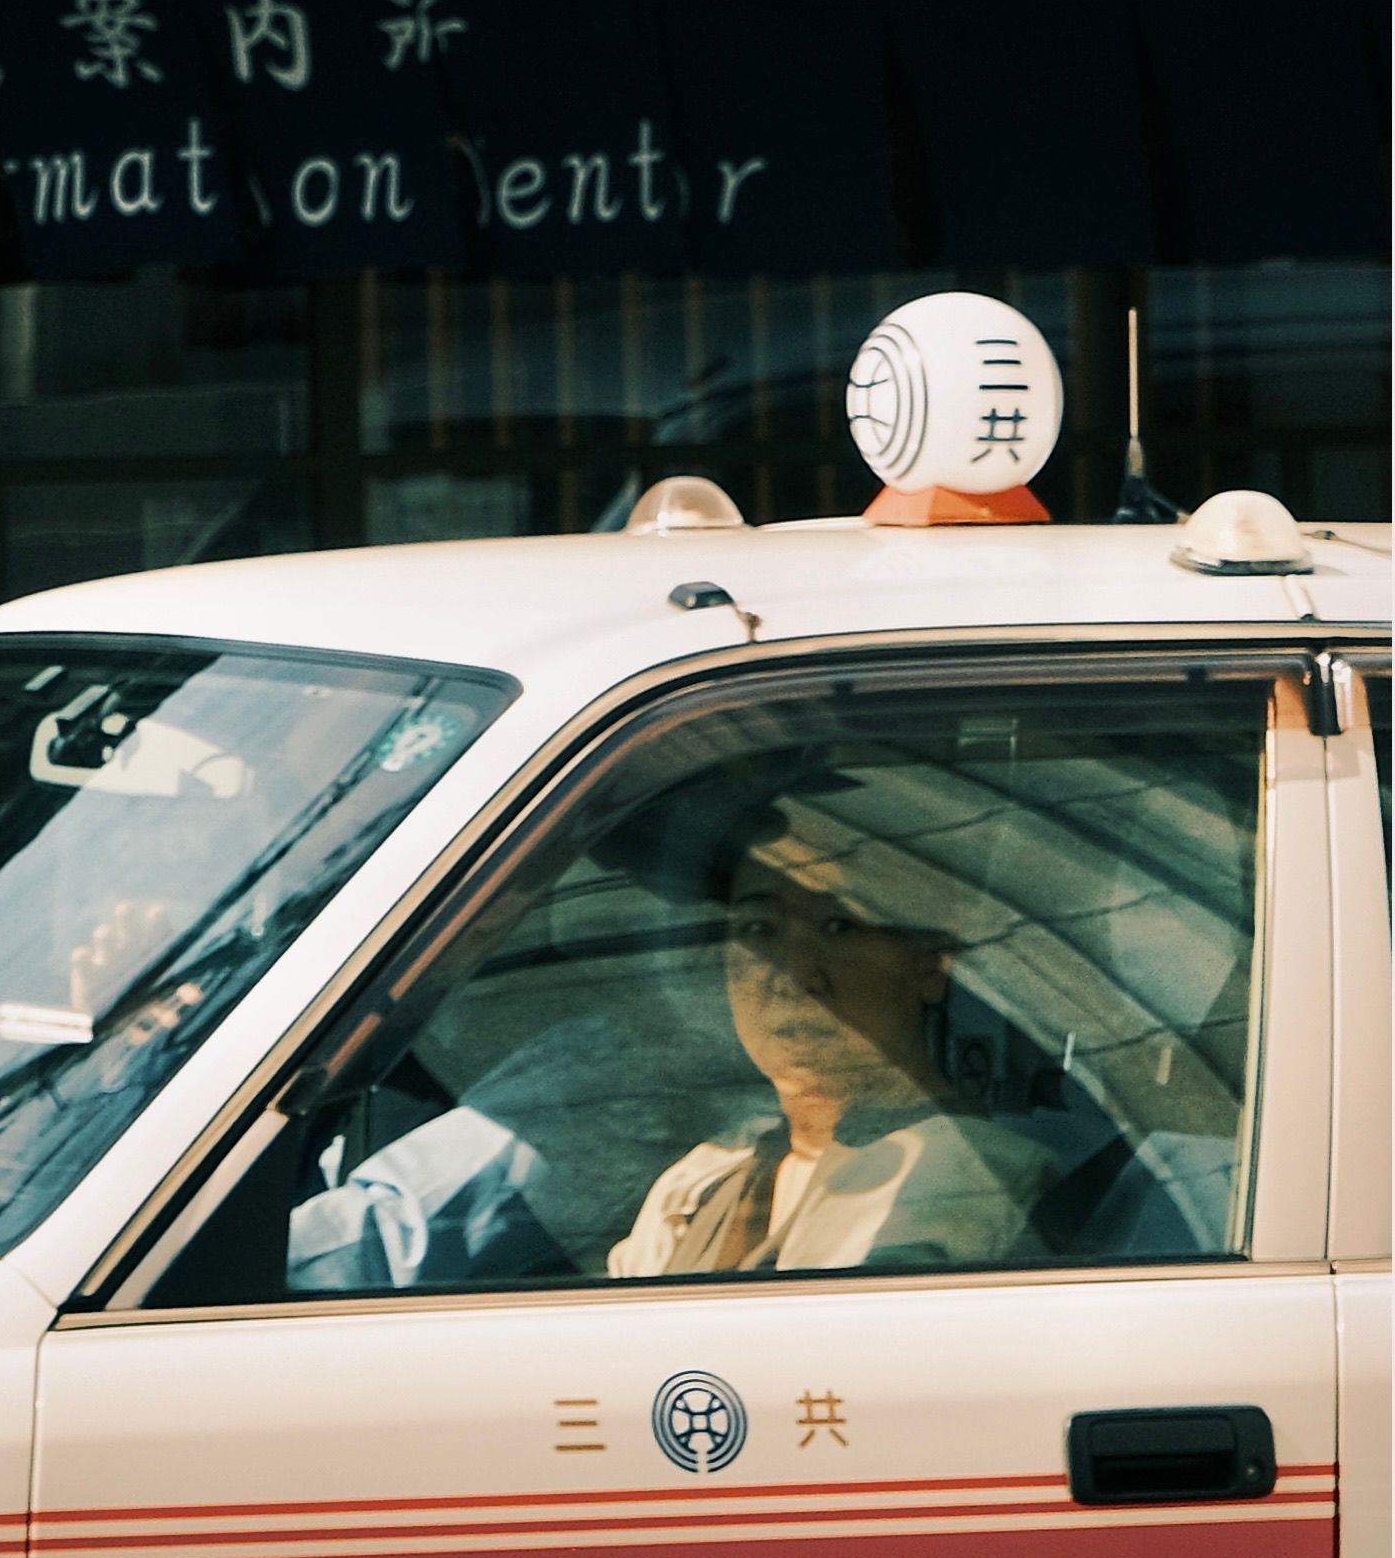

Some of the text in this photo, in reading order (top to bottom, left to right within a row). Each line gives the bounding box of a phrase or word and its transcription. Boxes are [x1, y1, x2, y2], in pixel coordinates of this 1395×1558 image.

[971, 339, 1029, 464] 三共
[553, 1389, 850, 1452] 三 共
